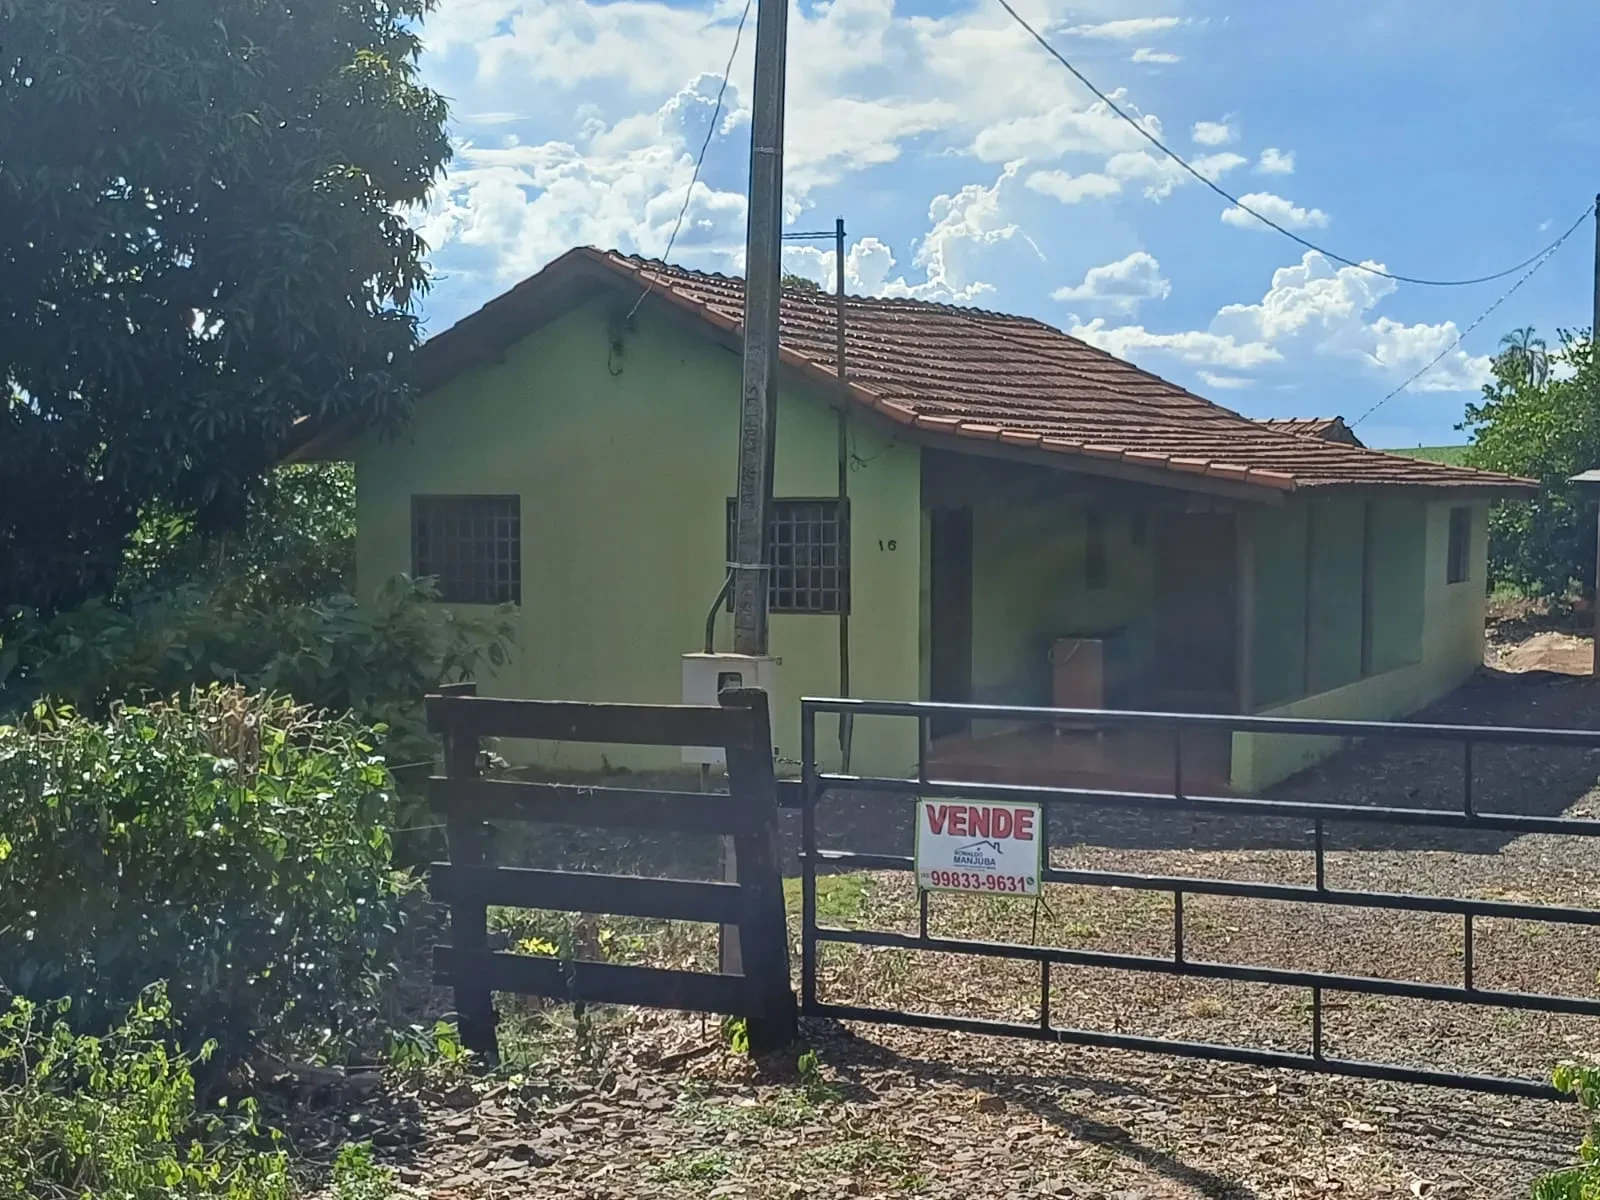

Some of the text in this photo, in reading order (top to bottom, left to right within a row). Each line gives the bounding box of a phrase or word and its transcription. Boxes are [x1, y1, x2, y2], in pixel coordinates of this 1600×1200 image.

[879, 539, 897, 552] 16
[926, 804, 1035, 841] VENDE
[953, 856, 996, 866] MANJUBA
[931, 870, 1026, 892] 99833-9631
